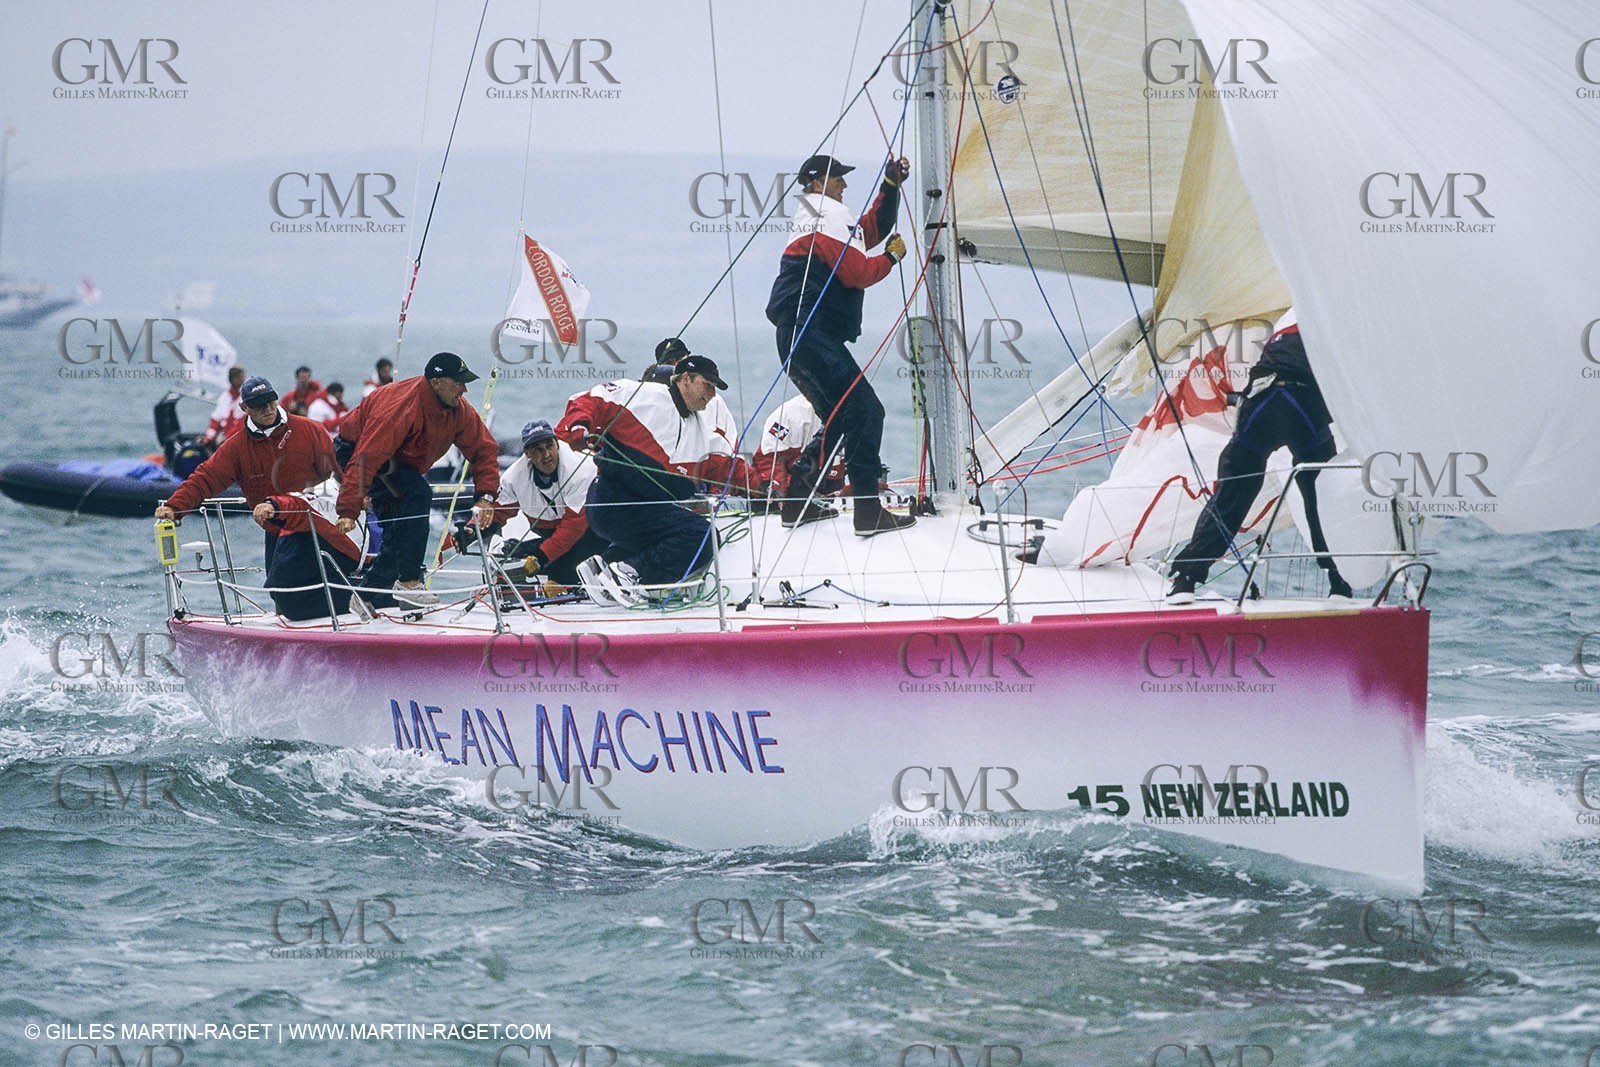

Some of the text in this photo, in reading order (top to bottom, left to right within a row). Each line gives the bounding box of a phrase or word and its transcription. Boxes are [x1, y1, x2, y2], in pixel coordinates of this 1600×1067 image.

[391, 700, 785, 785] MEAN MACHINE
[1067, 782, 1350, 817] 15 NEW ZEALAND
